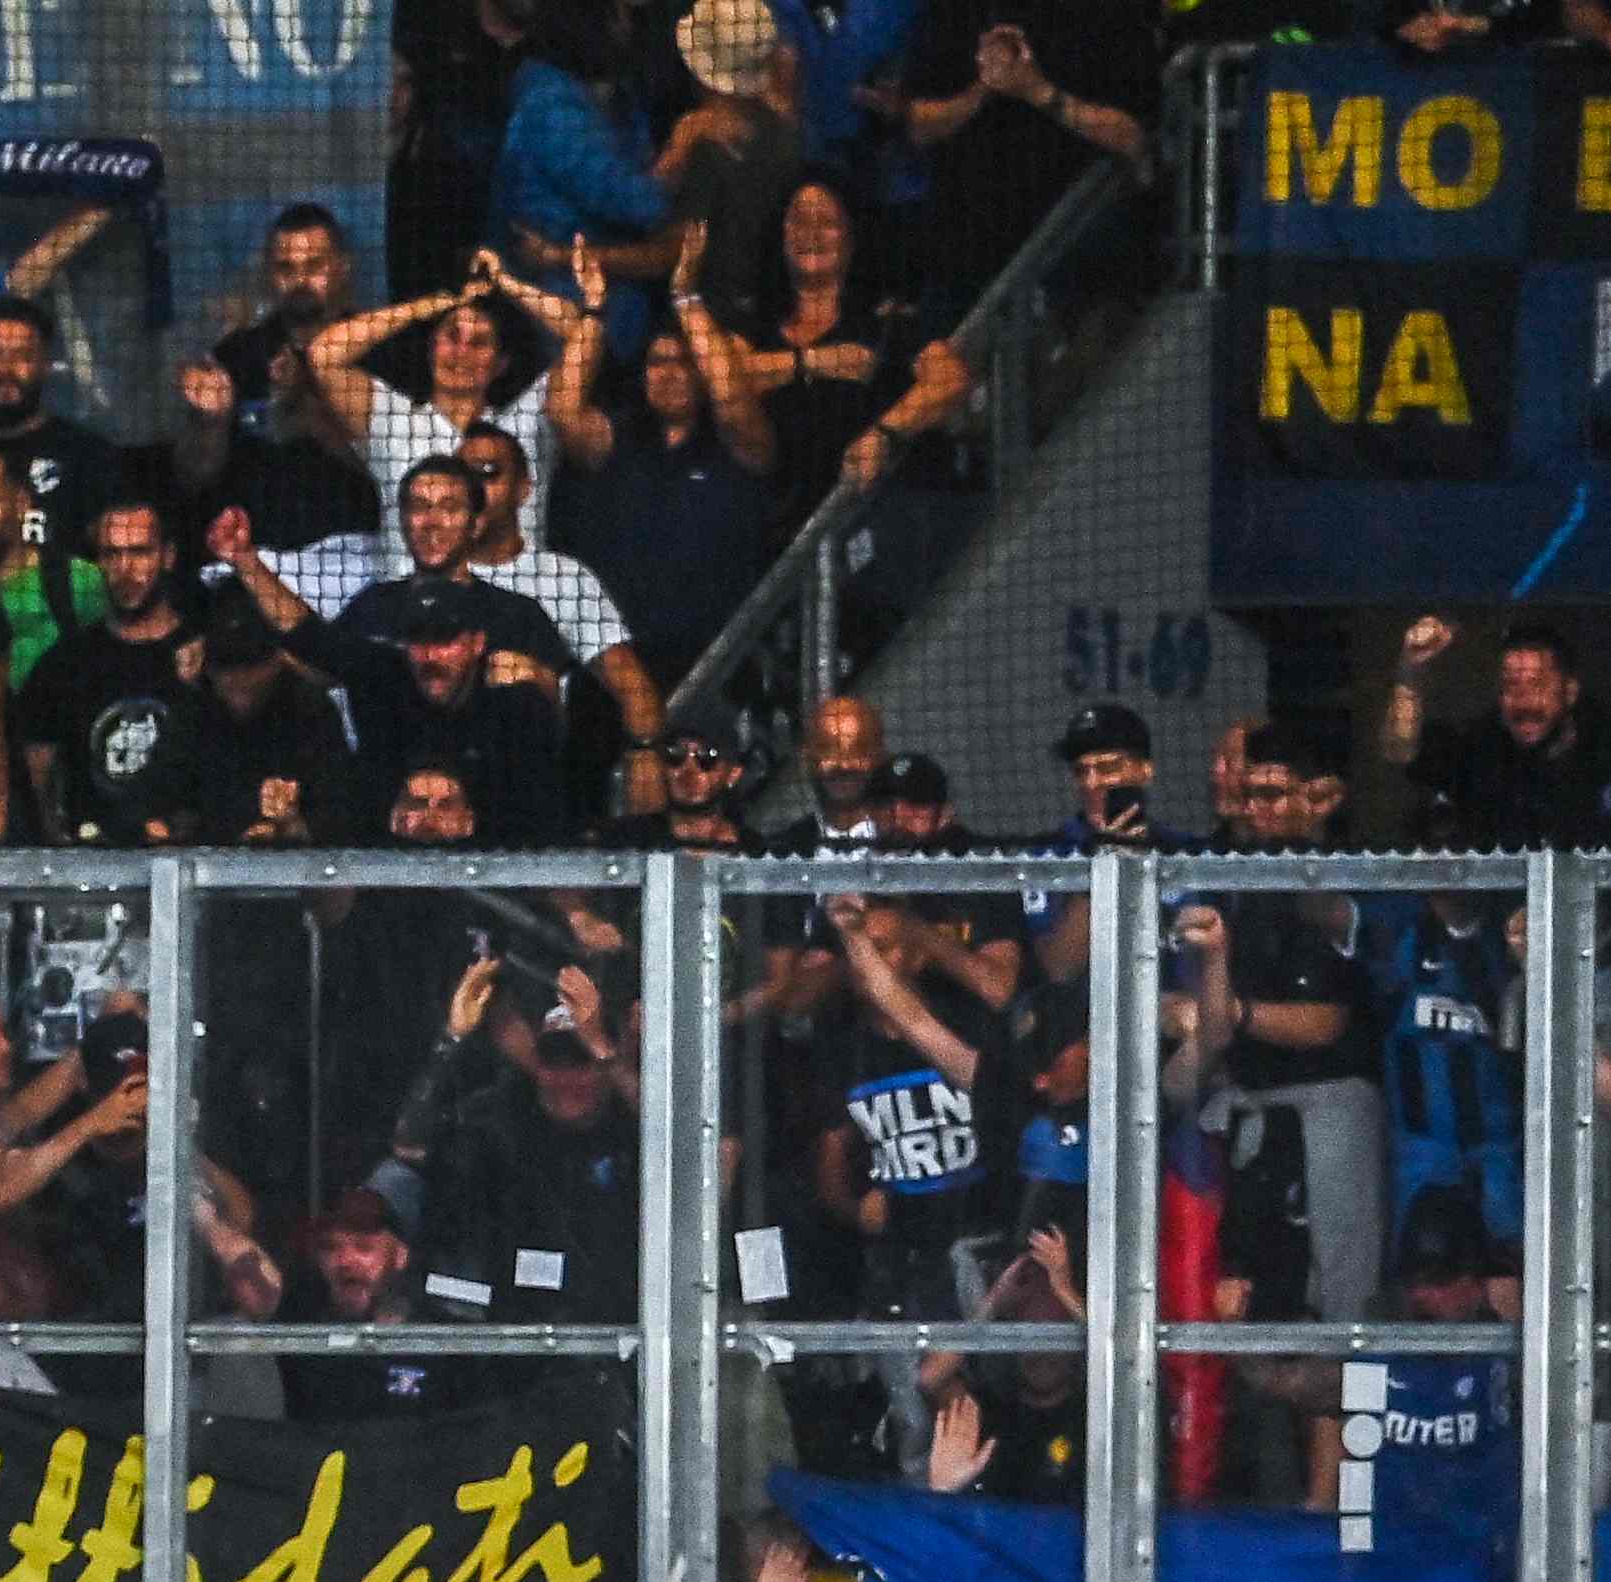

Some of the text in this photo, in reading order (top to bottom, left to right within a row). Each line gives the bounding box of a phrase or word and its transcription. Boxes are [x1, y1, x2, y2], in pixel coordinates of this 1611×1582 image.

[1265, 91, 1503, 211] MO
[1259, 307, 1473, 424] NA
[847, 1082, 973, 1142] MLN
